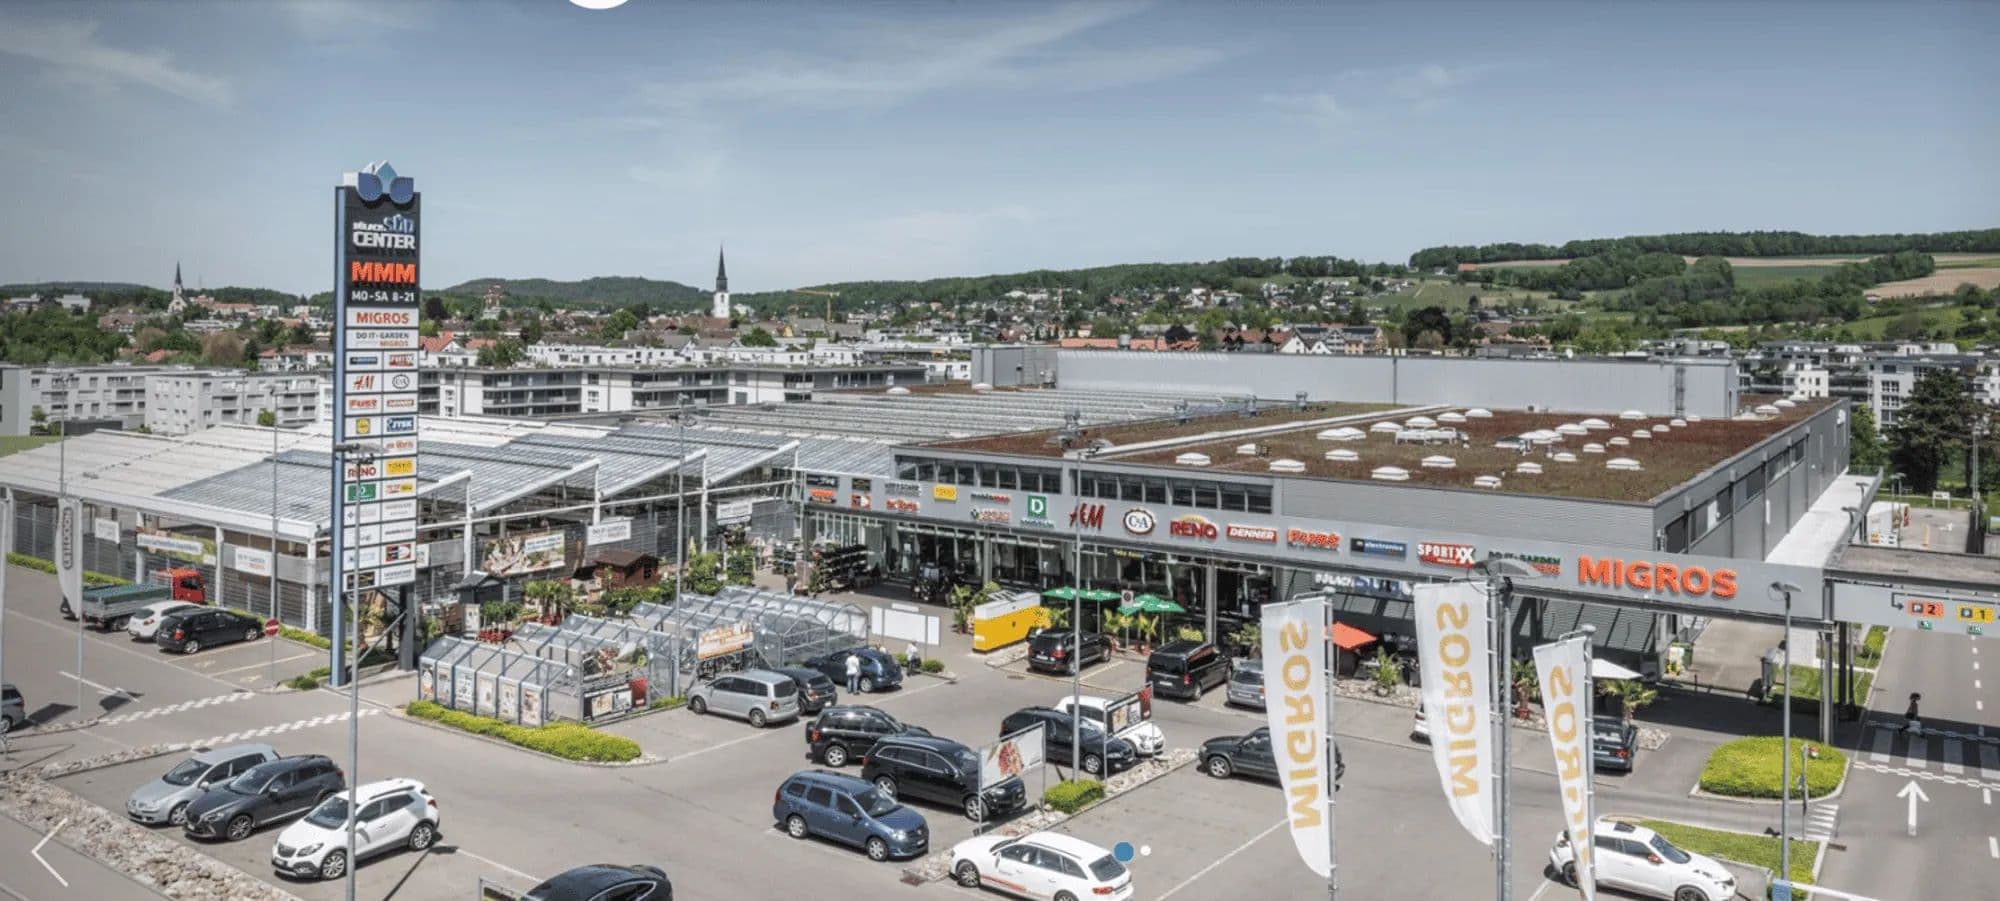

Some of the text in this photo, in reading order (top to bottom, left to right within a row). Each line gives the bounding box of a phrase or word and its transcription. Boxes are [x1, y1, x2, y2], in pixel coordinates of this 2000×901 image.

[353, 231, 415, 249] CENTER
[352, 261, 416, 284] MMM
[356, 312, 409, 324] MIGROS
[1031, 498, 1044, 514] D
[1128, 514, 1149, 529] C&A
[1170, 520, 1217, 539] RENO
[1229, 526, 1275, 541] DENNER
[1519, 554, 1560, 565] GARDEN
[1577, 553, 1738, 598] MIGROS
[1927, 604, 1936, 615] 2
